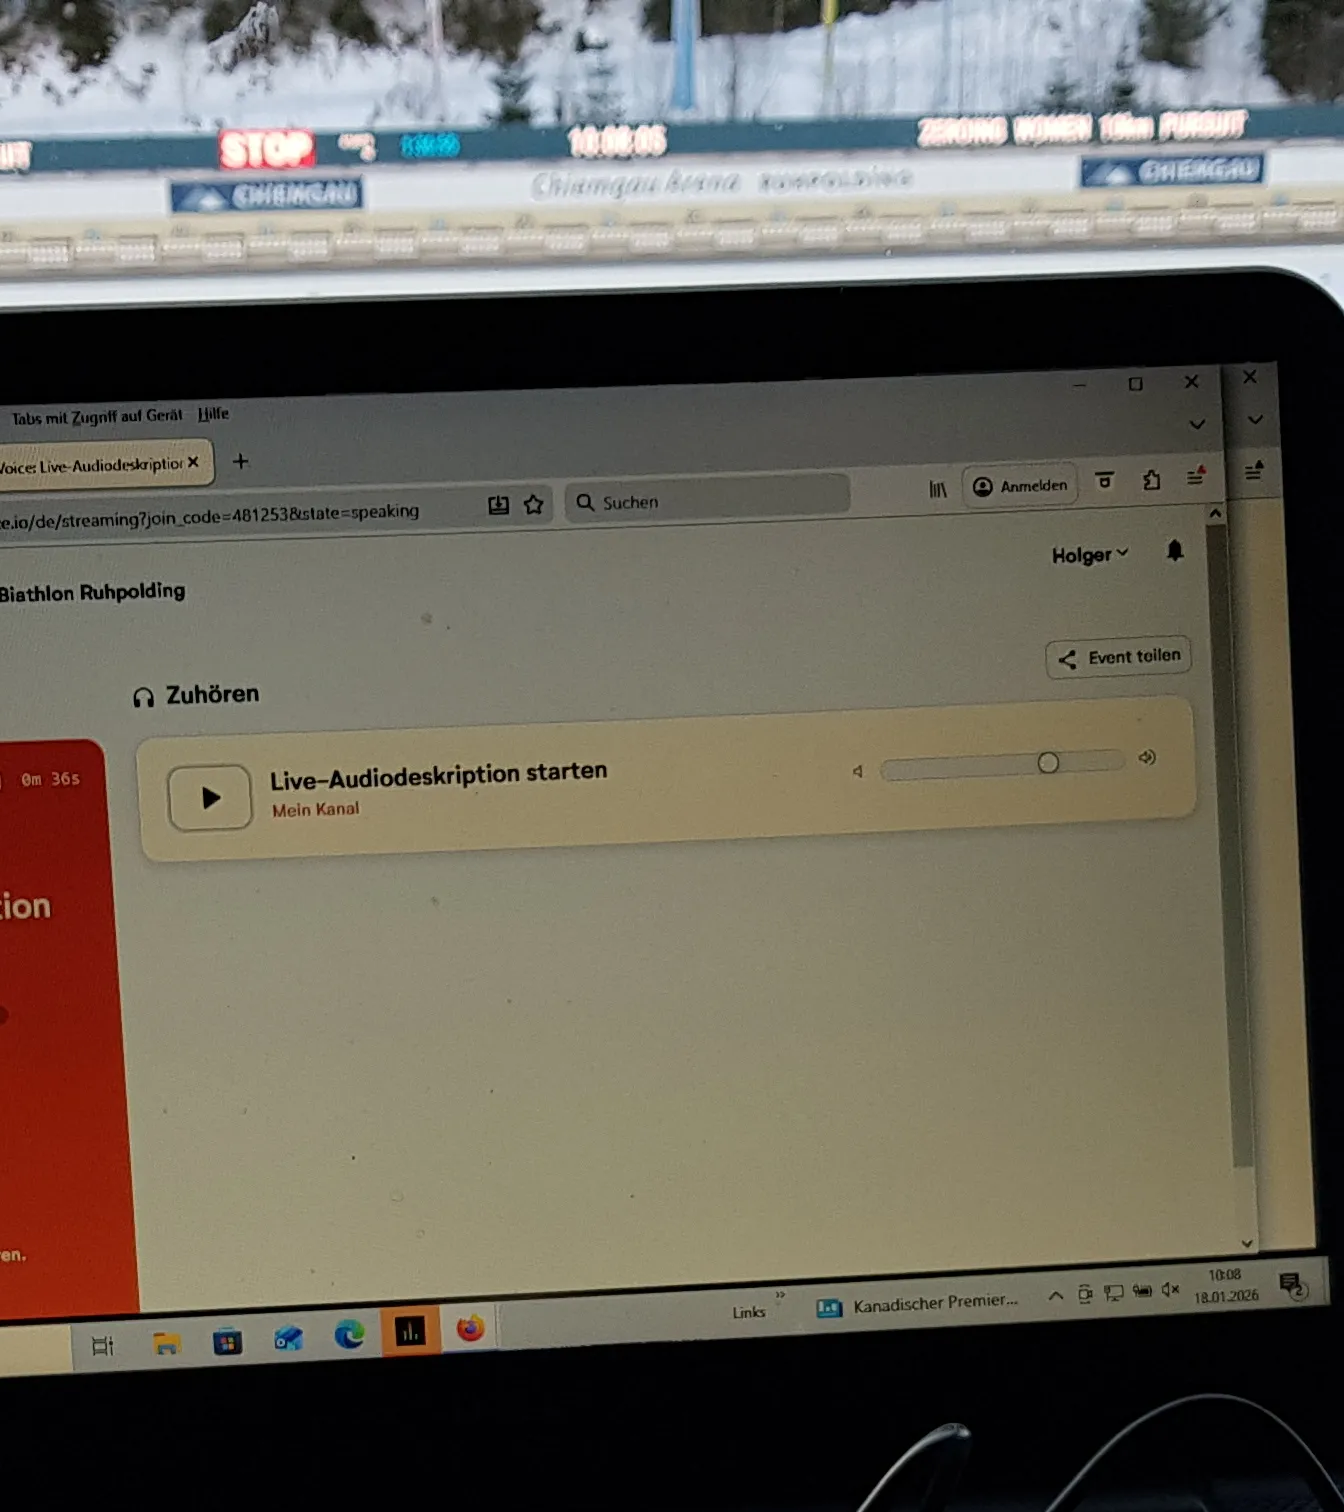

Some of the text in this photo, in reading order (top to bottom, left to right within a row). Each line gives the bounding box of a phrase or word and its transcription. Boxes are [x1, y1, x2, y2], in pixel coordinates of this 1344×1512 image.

[220, 131, 313, 168] STOP
[13, 413, 42, 426] Tabs
[46, 412, 68, 425] mit
[71, 410, 118, 427] Zugriff
[121, 409, 143, 423] auf
[146, 408, 184, 422] Gerät
[197, 407, 230, 424] Hilfe
[1000, 478, 1068, 494] Anmelden
[602, 494, 658, 511] Suchen
[1052, 545, 1112, 566] Holger
[79, 581, 186, 603] Ruhpolding
[1088, 647, 1181, 665] Event teilen
[166, 684, 260, 705] Zuhören
[51, 770, 81, 786] 36s
[270, 761, 608, 792] Live-Audiodeskription starten
[272, 800, 360, 819] Mein Kanal
[1208, 1267, 1242, 1282] 10:08
[733, 1305, 766, 1320] Links
[854, 1292, 1019, 1314] Kanadischer Premier...
